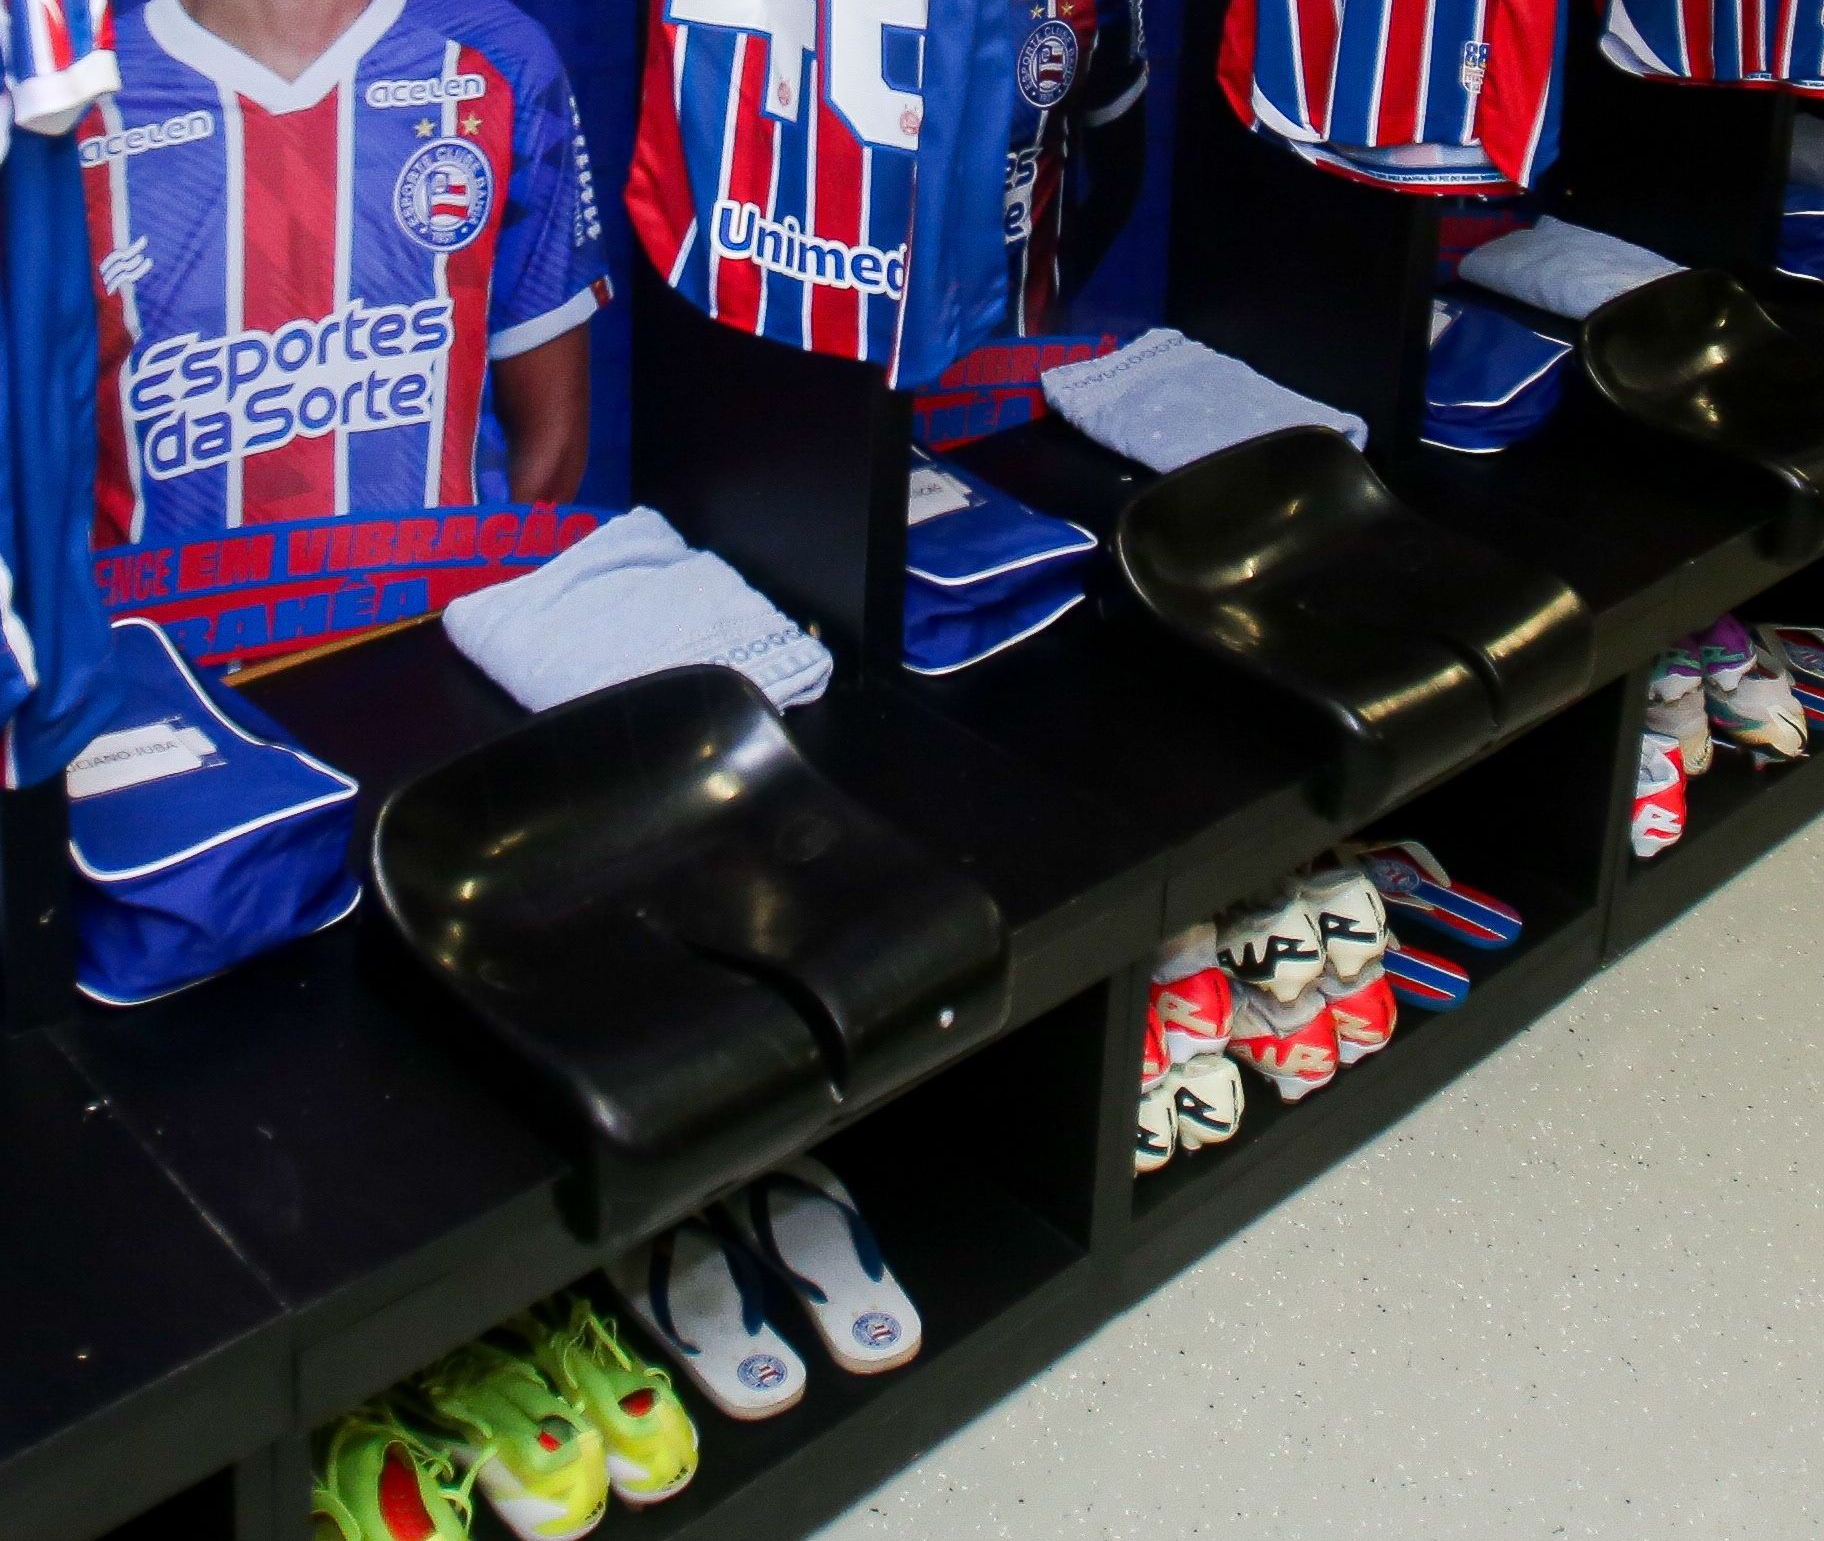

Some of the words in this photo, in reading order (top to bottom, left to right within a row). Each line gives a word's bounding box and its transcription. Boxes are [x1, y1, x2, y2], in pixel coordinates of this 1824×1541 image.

[365, 73, 485, 109] acelen
[129, 297, 453, 419] Esportes
[177, 536, 273, 593] EM
